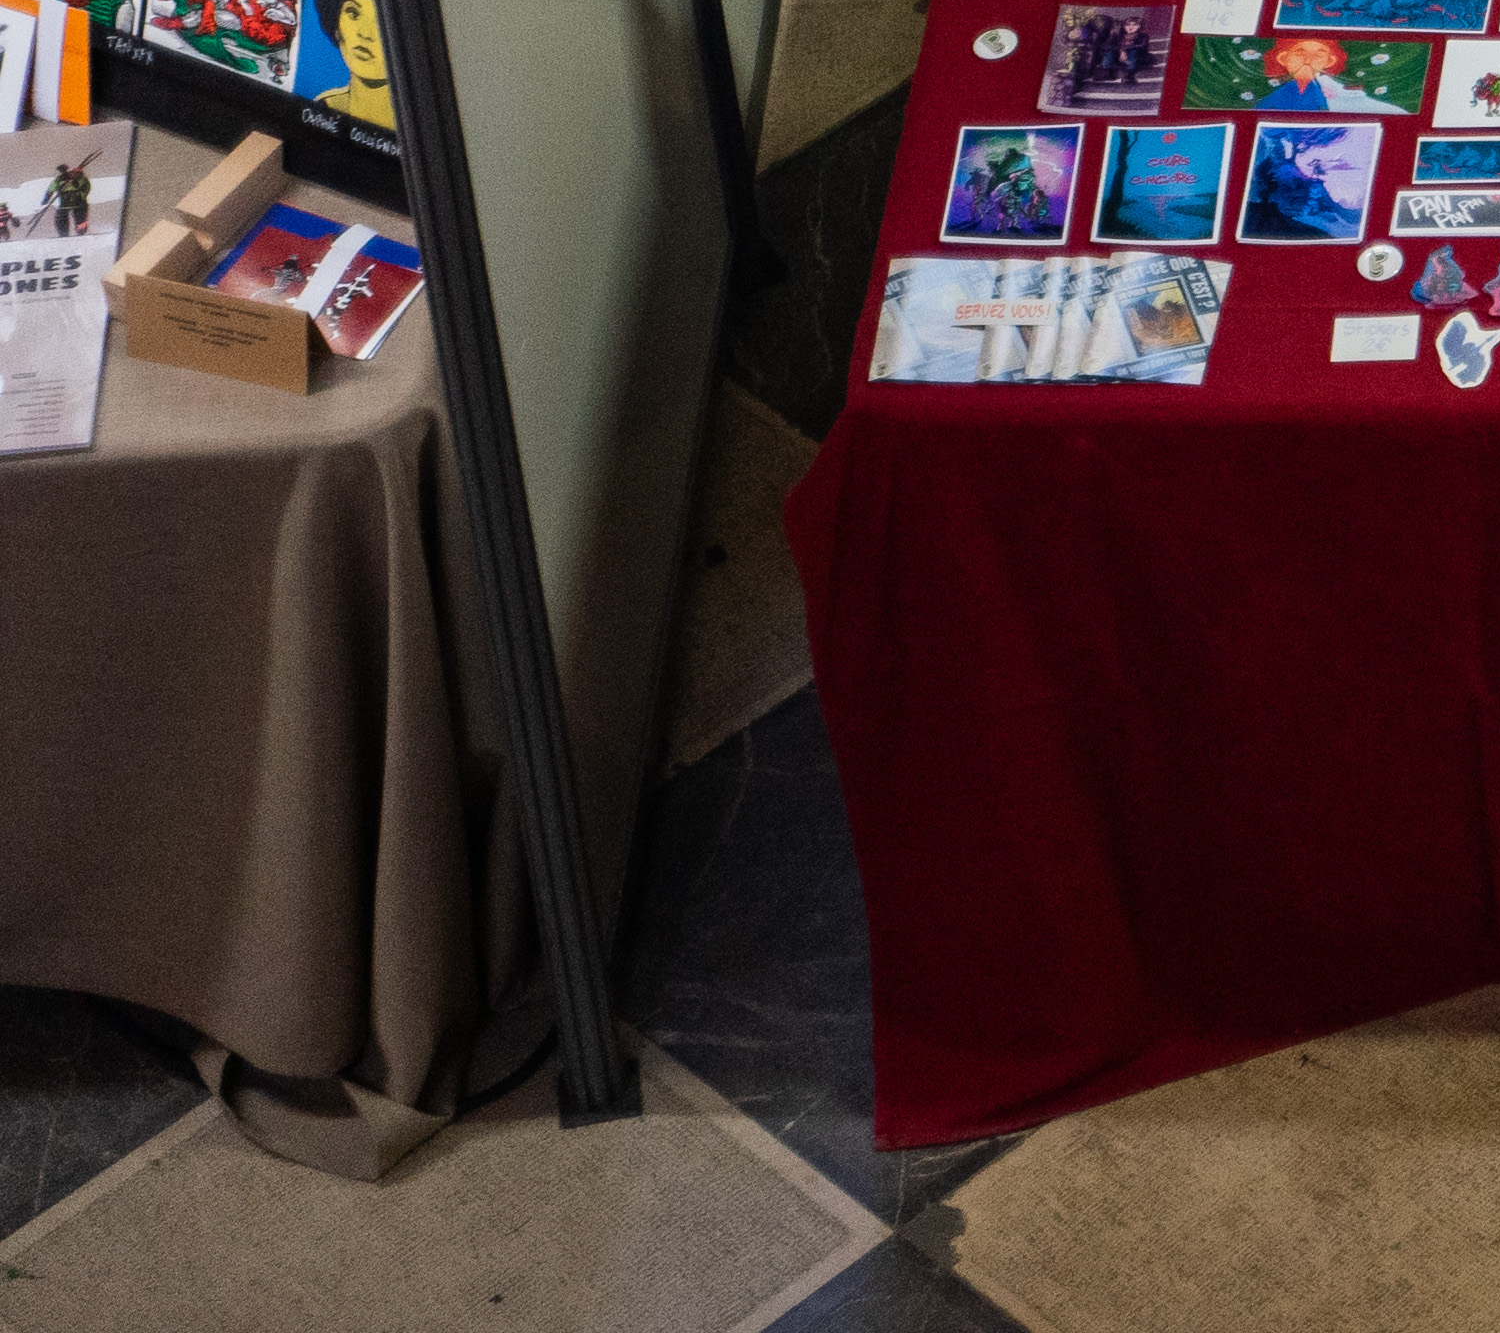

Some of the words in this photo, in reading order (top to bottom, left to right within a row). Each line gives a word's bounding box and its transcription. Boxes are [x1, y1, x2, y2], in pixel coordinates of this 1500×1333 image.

[1407, 194, 1452, 220] PAN
[1459, 196, 1486, 214] PAN
[1432, 211, 1474, 230] PAN
[954, 302, 1006, 320] SERVEZ
